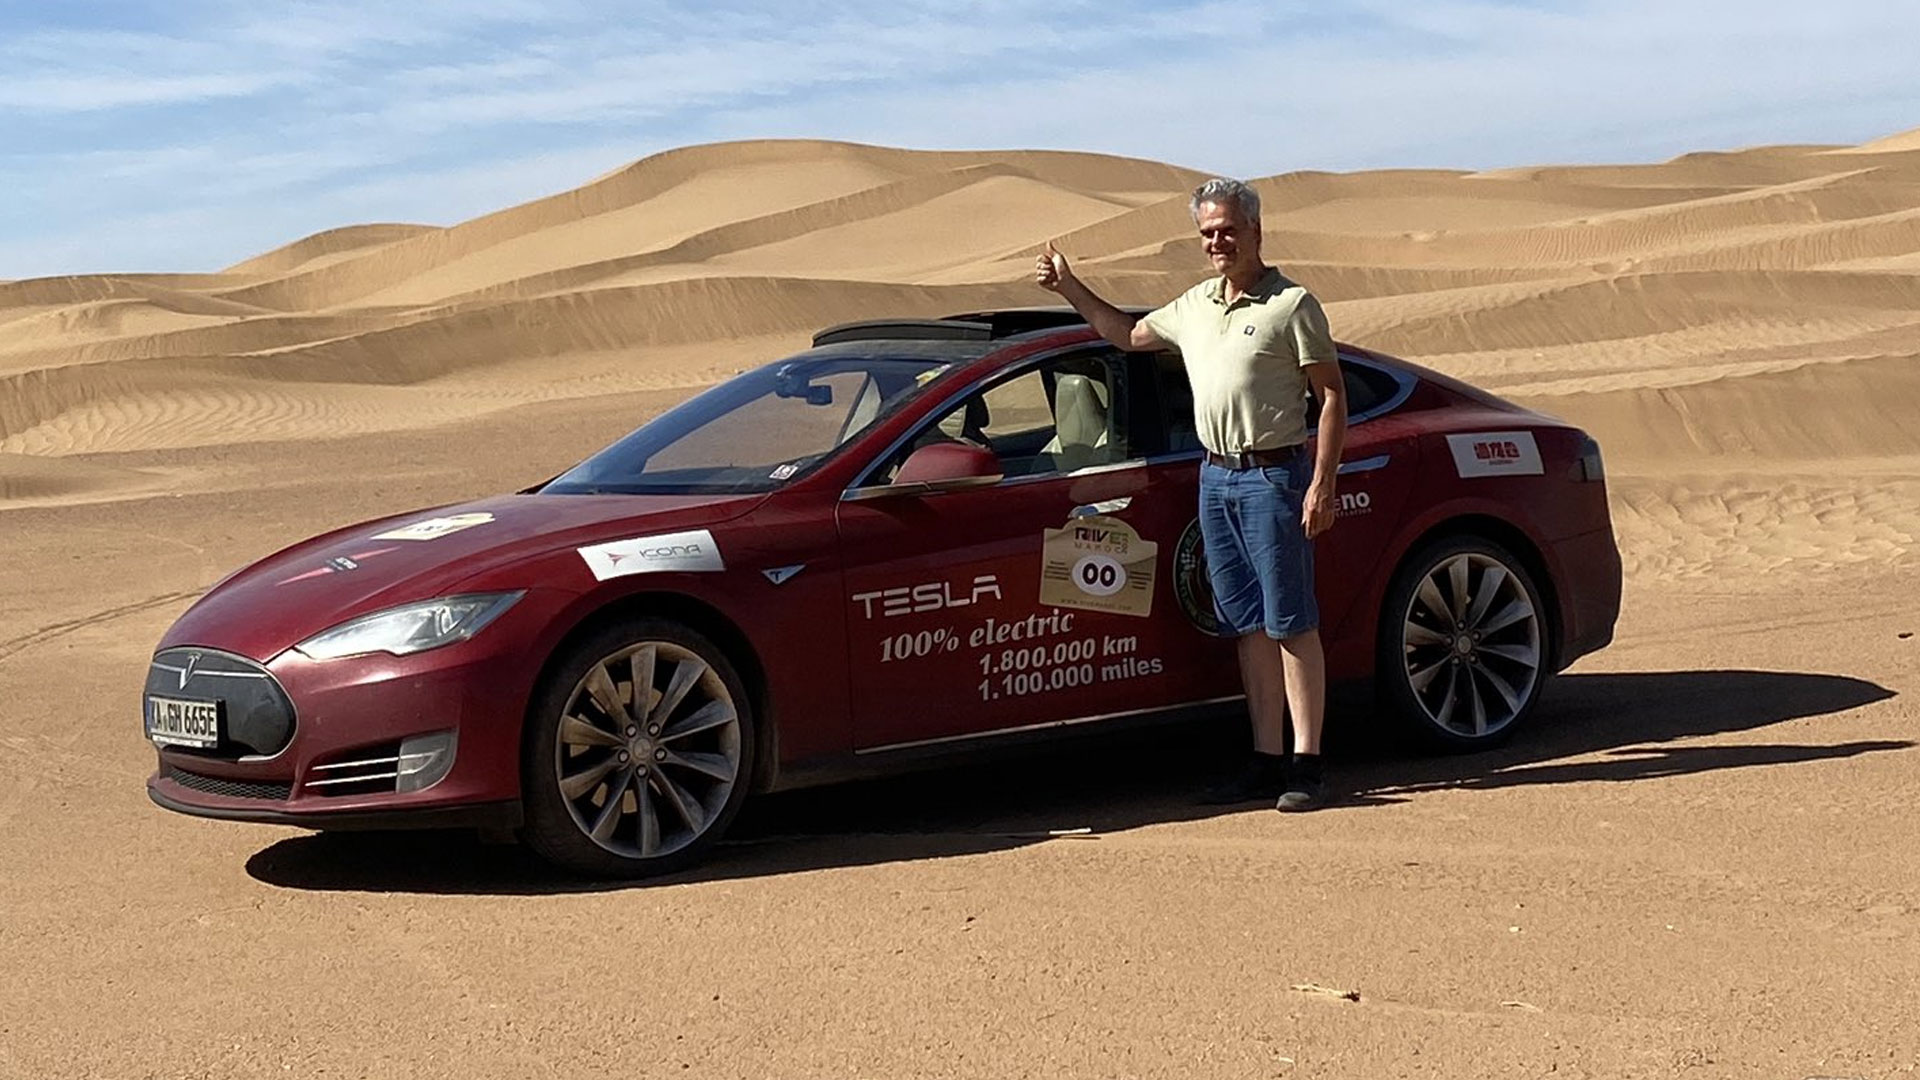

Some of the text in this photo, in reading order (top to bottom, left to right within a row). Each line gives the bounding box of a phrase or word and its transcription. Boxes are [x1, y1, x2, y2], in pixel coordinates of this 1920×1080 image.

[1082, 563, 1116, 587] 00
[852, 575, 1002, 619] TESLA
[880, 608, 1075, 662] 100% electric
[979, 634, 1137, 675] 1.800.000 km
[978, 657, 1164, 701] 1.100.000 miles
[184, 705, 216, 736] 665E
